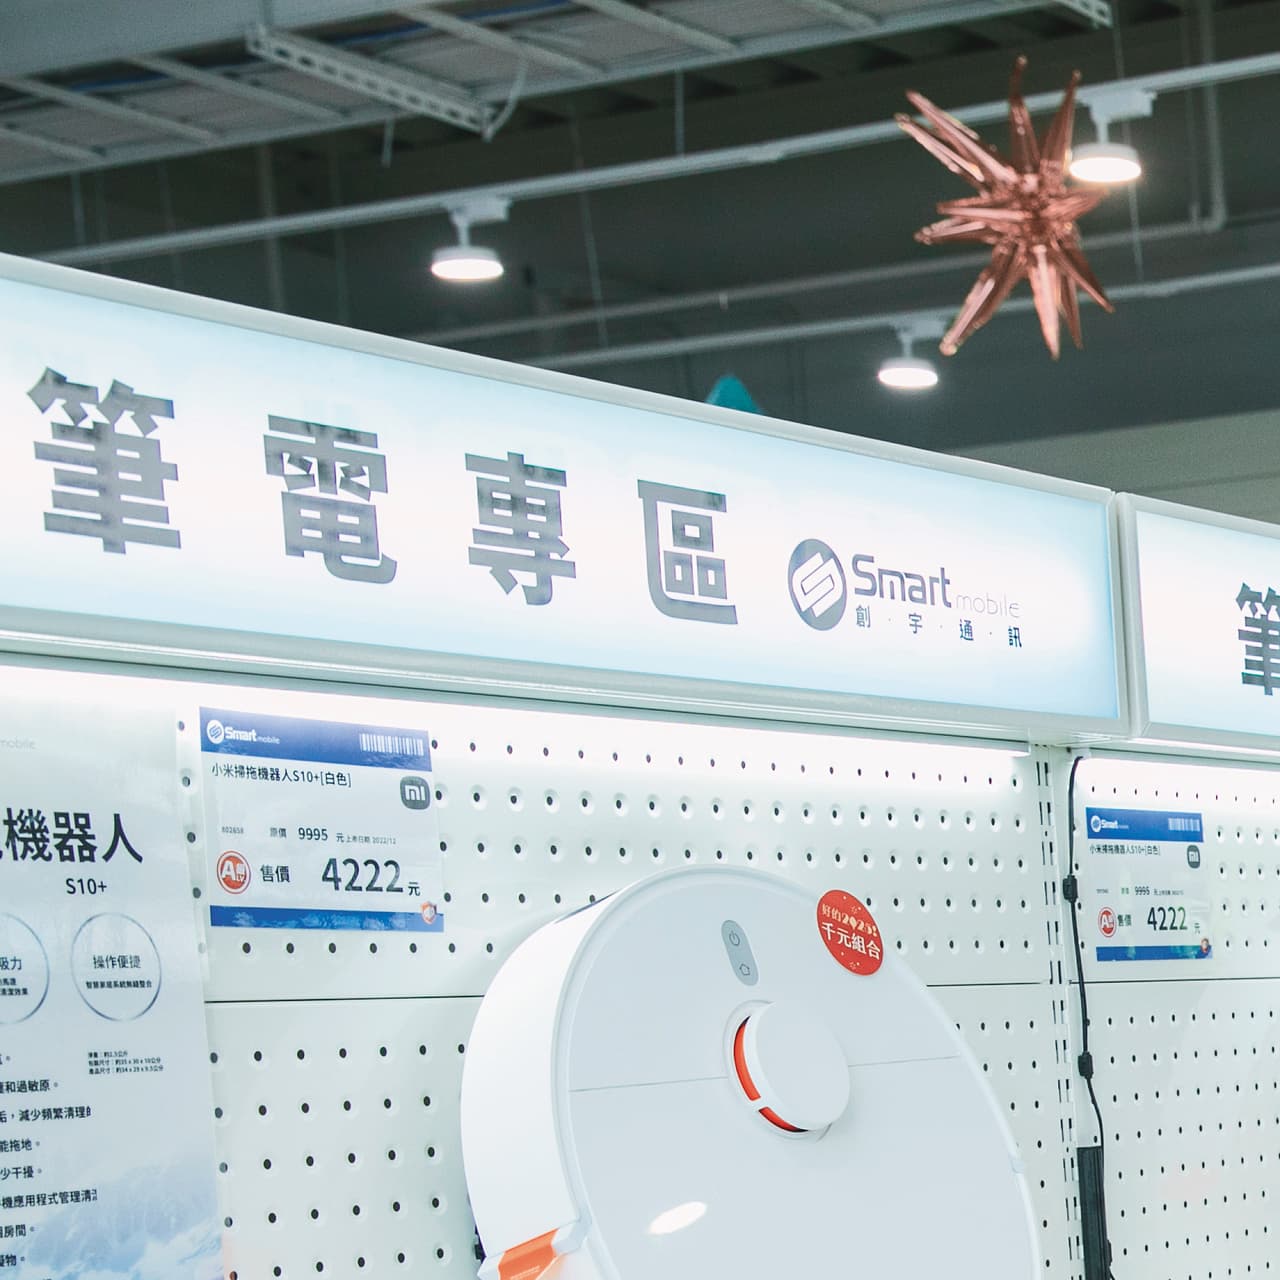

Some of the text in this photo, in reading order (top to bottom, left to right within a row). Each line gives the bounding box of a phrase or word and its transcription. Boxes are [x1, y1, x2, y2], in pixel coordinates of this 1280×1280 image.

[27, 367, 738, 625] 筆電專區
[852, 554, 1021, 618] Smart mobile
[225, 727, 257, 742] Smart
[212, 763, 352, 787] 小米掃拖機器人S10+[白色]
[3, 807, 144, 865] 機器人
[298, 827, 328, 841] 9995
[66, 878, 107, 895] S10+
[260, 865, 290, 883] 售價
[321, 858, 403, 892] 4222
[408, 882, 421, 896] 元
[1147, 906, 1187, 931] 4222
[822, 921, 881, 961] 千元組合
[93, 955, 141, 970] 操作便捷
